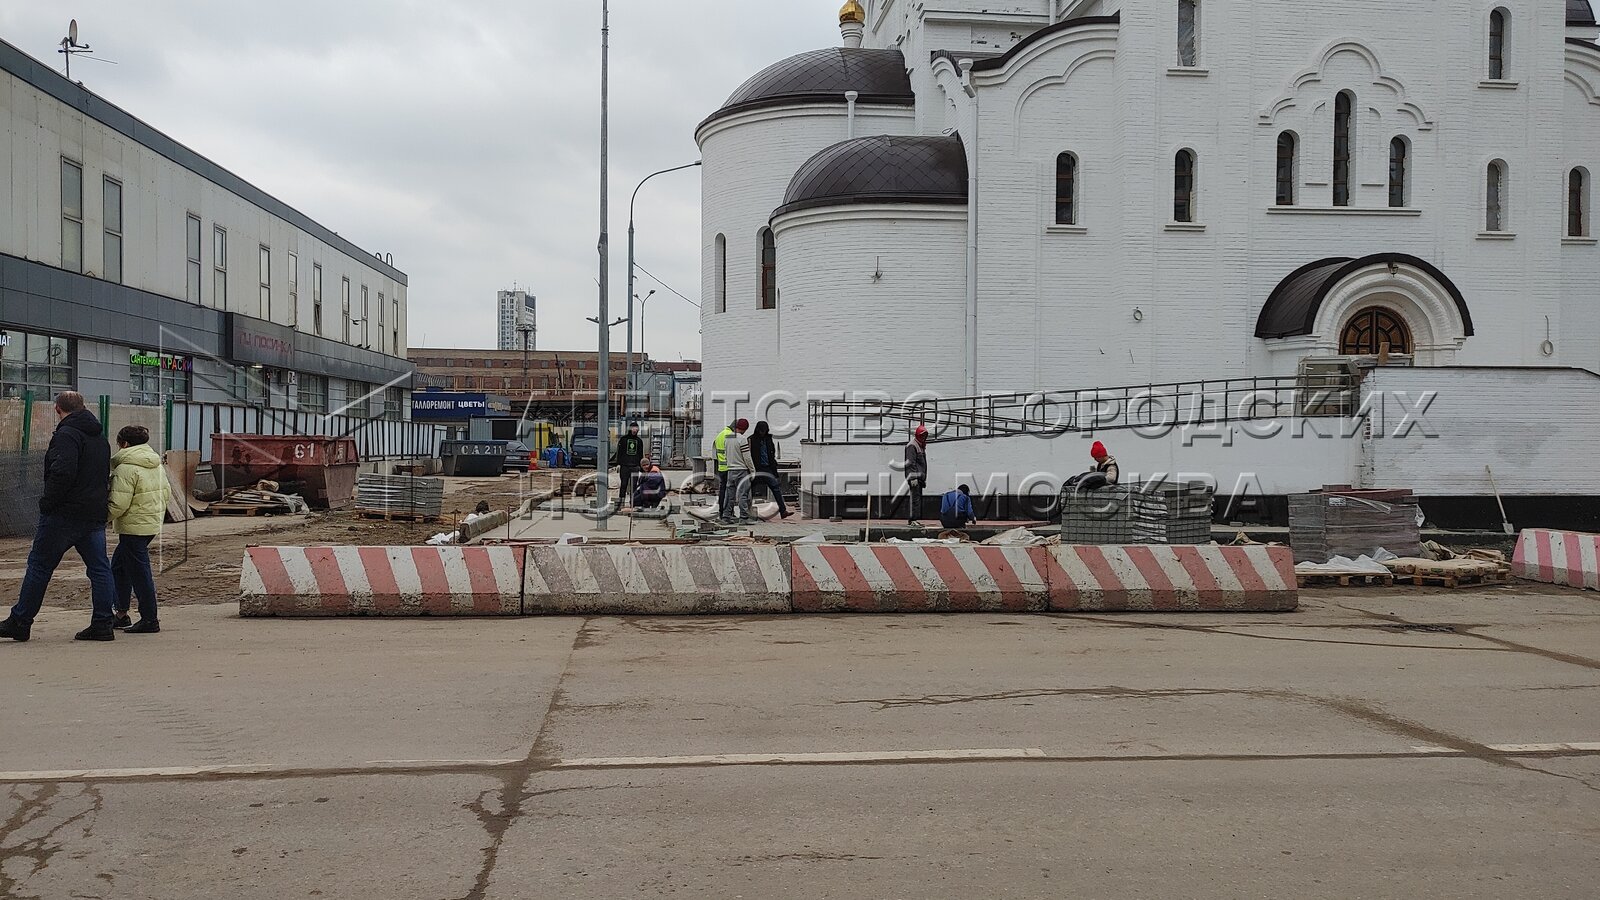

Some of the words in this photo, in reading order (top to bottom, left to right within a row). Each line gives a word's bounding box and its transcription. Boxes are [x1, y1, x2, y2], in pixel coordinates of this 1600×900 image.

[0, 335, 11, 347] АГ
[162, 356, 193, 372] КРАСКИ
[458, 400, 485, 409] ЦВЕТЫ
[294, 442, 315, 459] 61
[484, 445, 502, 455] 211
